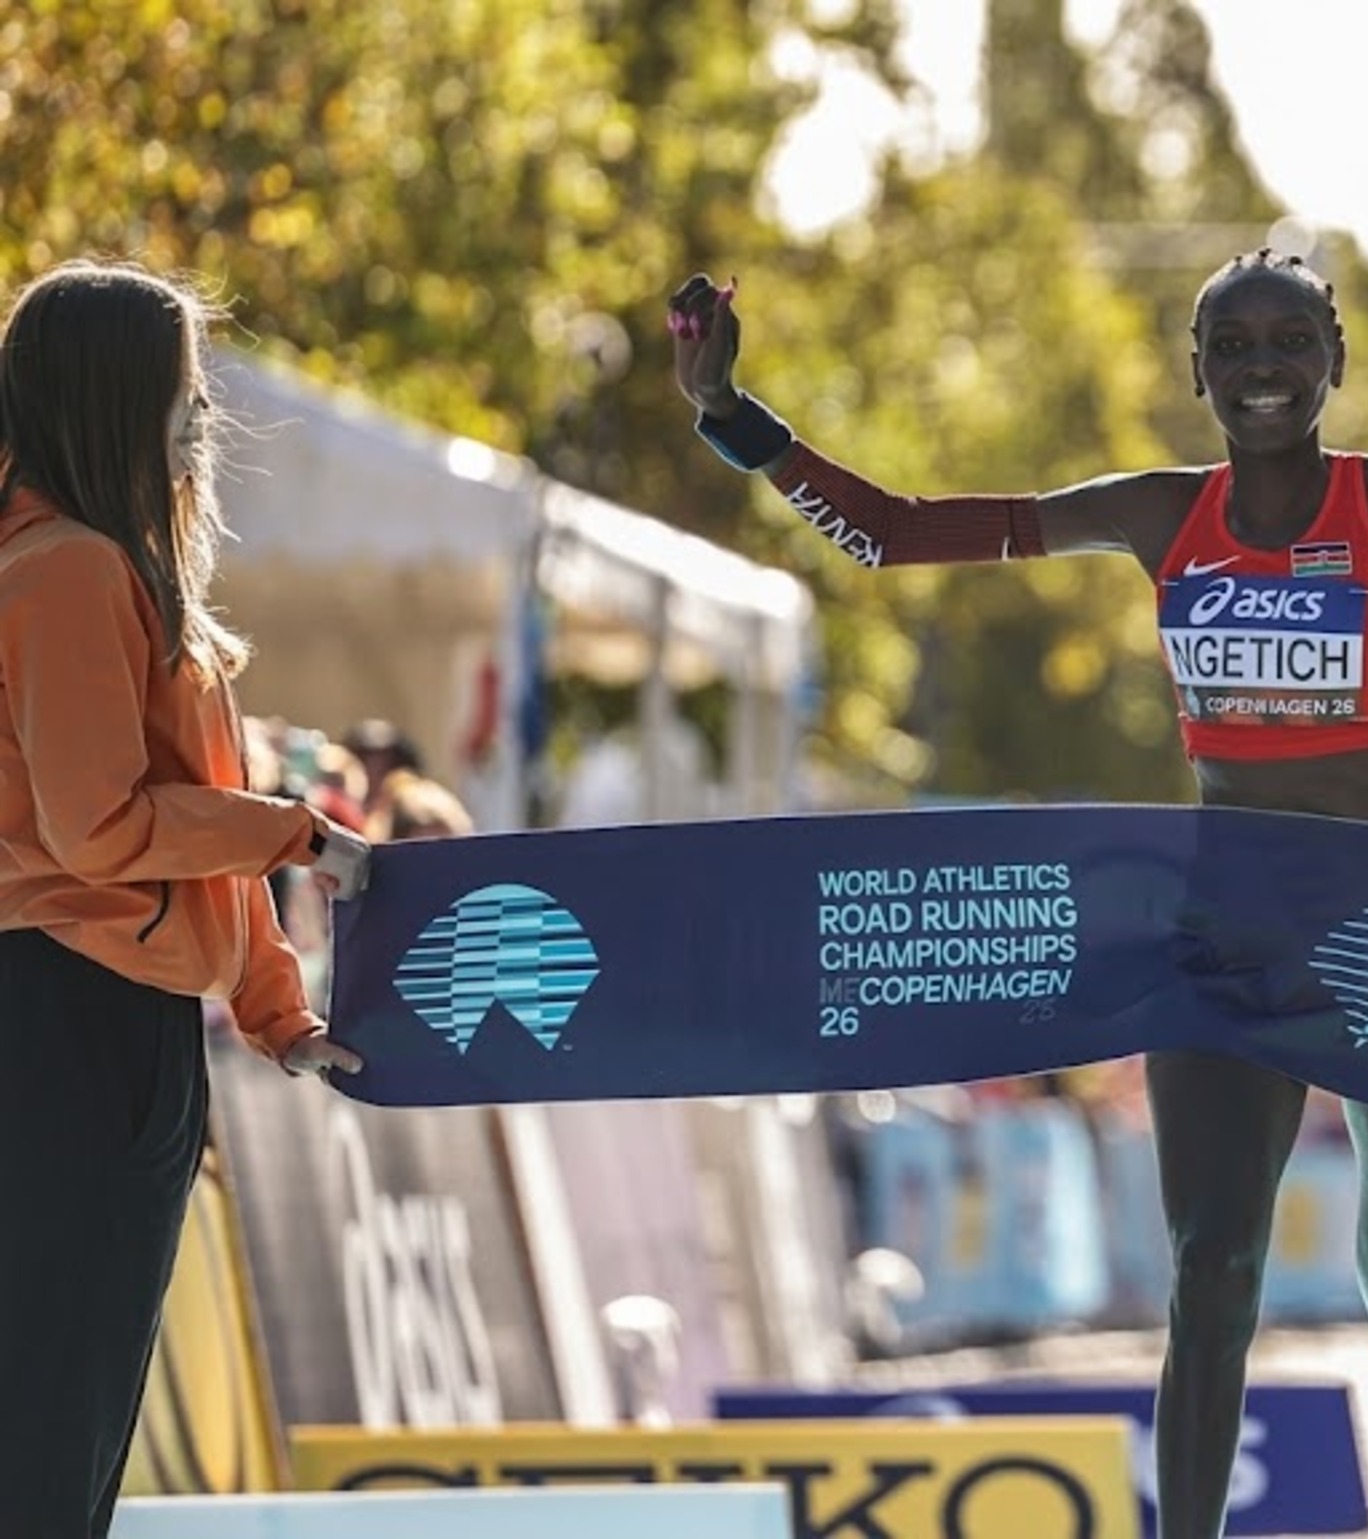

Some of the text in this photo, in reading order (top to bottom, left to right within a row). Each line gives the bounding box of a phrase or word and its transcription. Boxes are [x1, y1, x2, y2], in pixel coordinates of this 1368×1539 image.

[788, 482, 882, 569] KENYA
[1231, 588, 1326, 621] asics
[1170, 634, 1350, 682] NGETICH
[1332, 699, 1355, 714] 26
[818, 863, 1071, 898] WORLD ATHLETICS
[819, 896, 1078, 935] ROAD RUNNING
[819, 934, 1077, 970] CHAMPIONSHIPS
[859, 969, 1072, 1005] COPENHAGEN
[819, 1007, 859, 1037] 26
